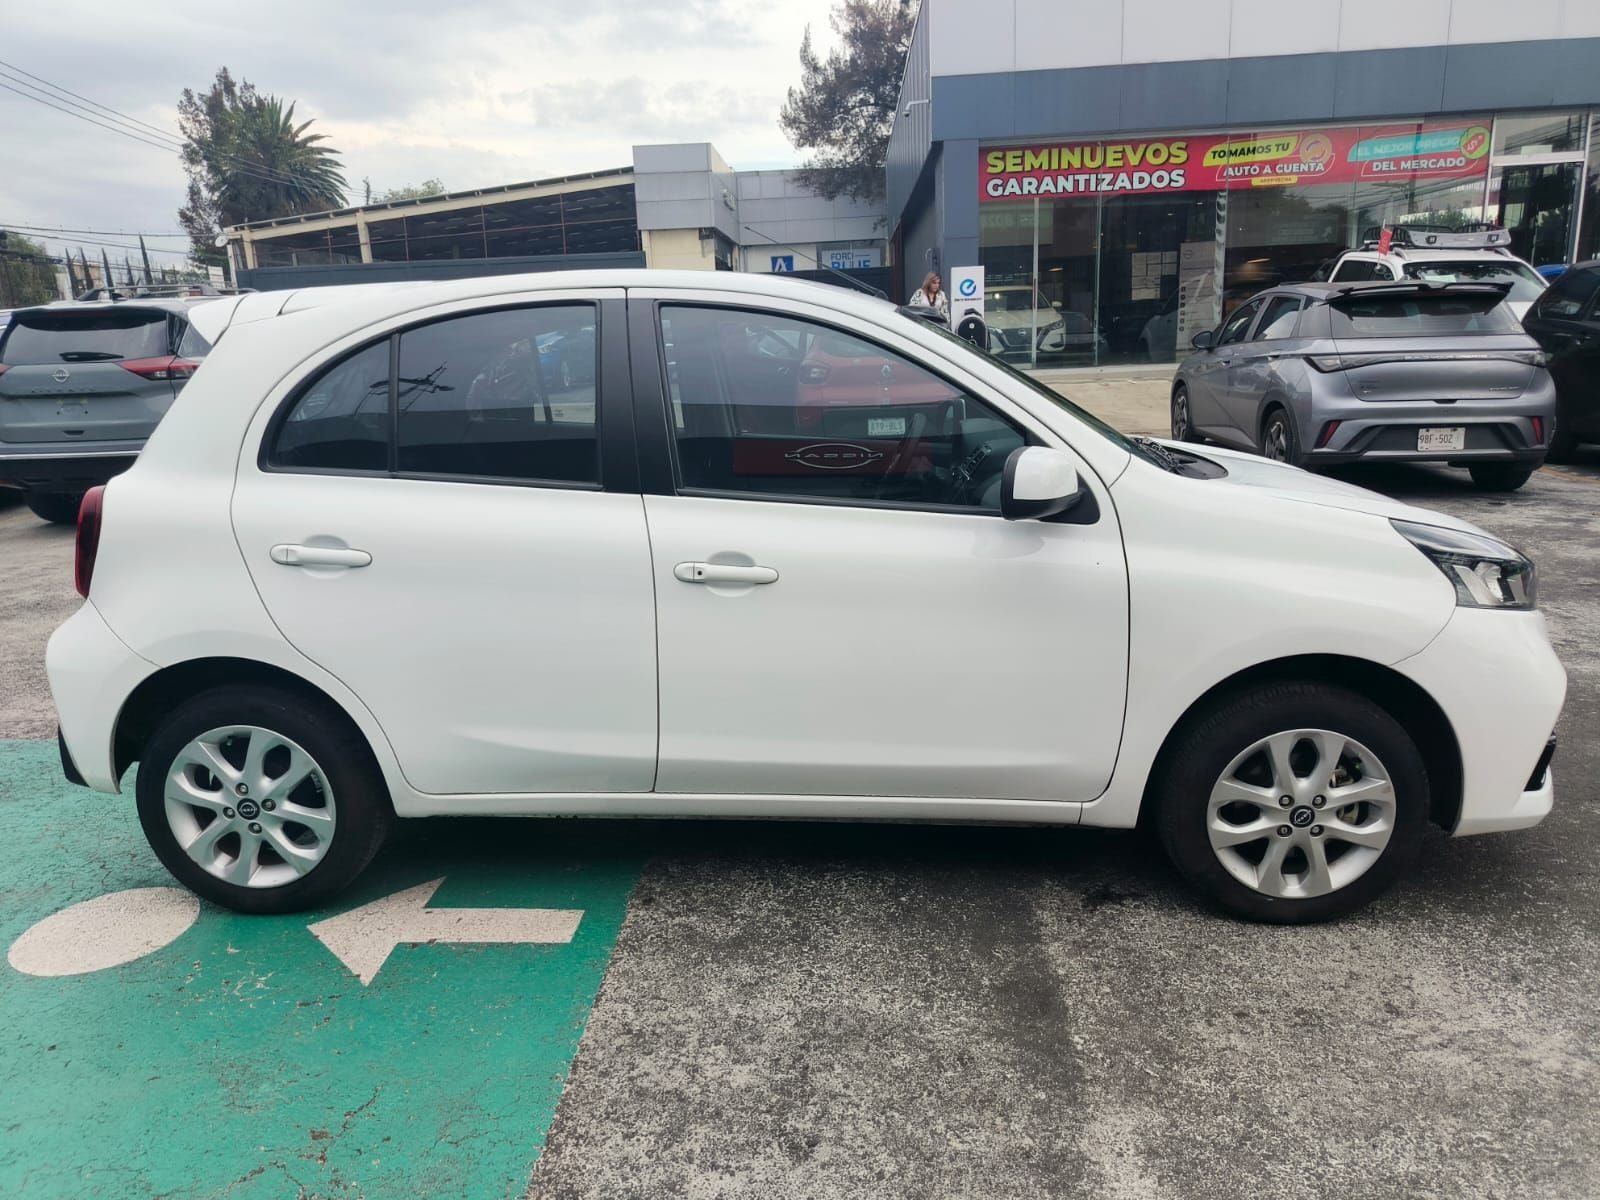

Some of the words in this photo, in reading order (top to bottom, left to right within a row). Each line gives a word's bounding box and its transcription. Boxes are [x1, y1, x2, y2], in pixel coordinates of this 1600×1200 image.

[986, 142, 1188, 173] SEMINUEVOS
[1211, 145, 1272, 159] TOMAMOS
[1275, 142, 1290, 151] TU
[1223, 165, 1260, 177] AUTO
[1262, 165, 1273, 174] A
[1275, 162, 1325, 174] CUENTA
[1372, 161, 1396, 172] DEL
[1400, 157, 1466, 170] MERCADO
[986, 169, 1186, 197] GARANTIZADOS
